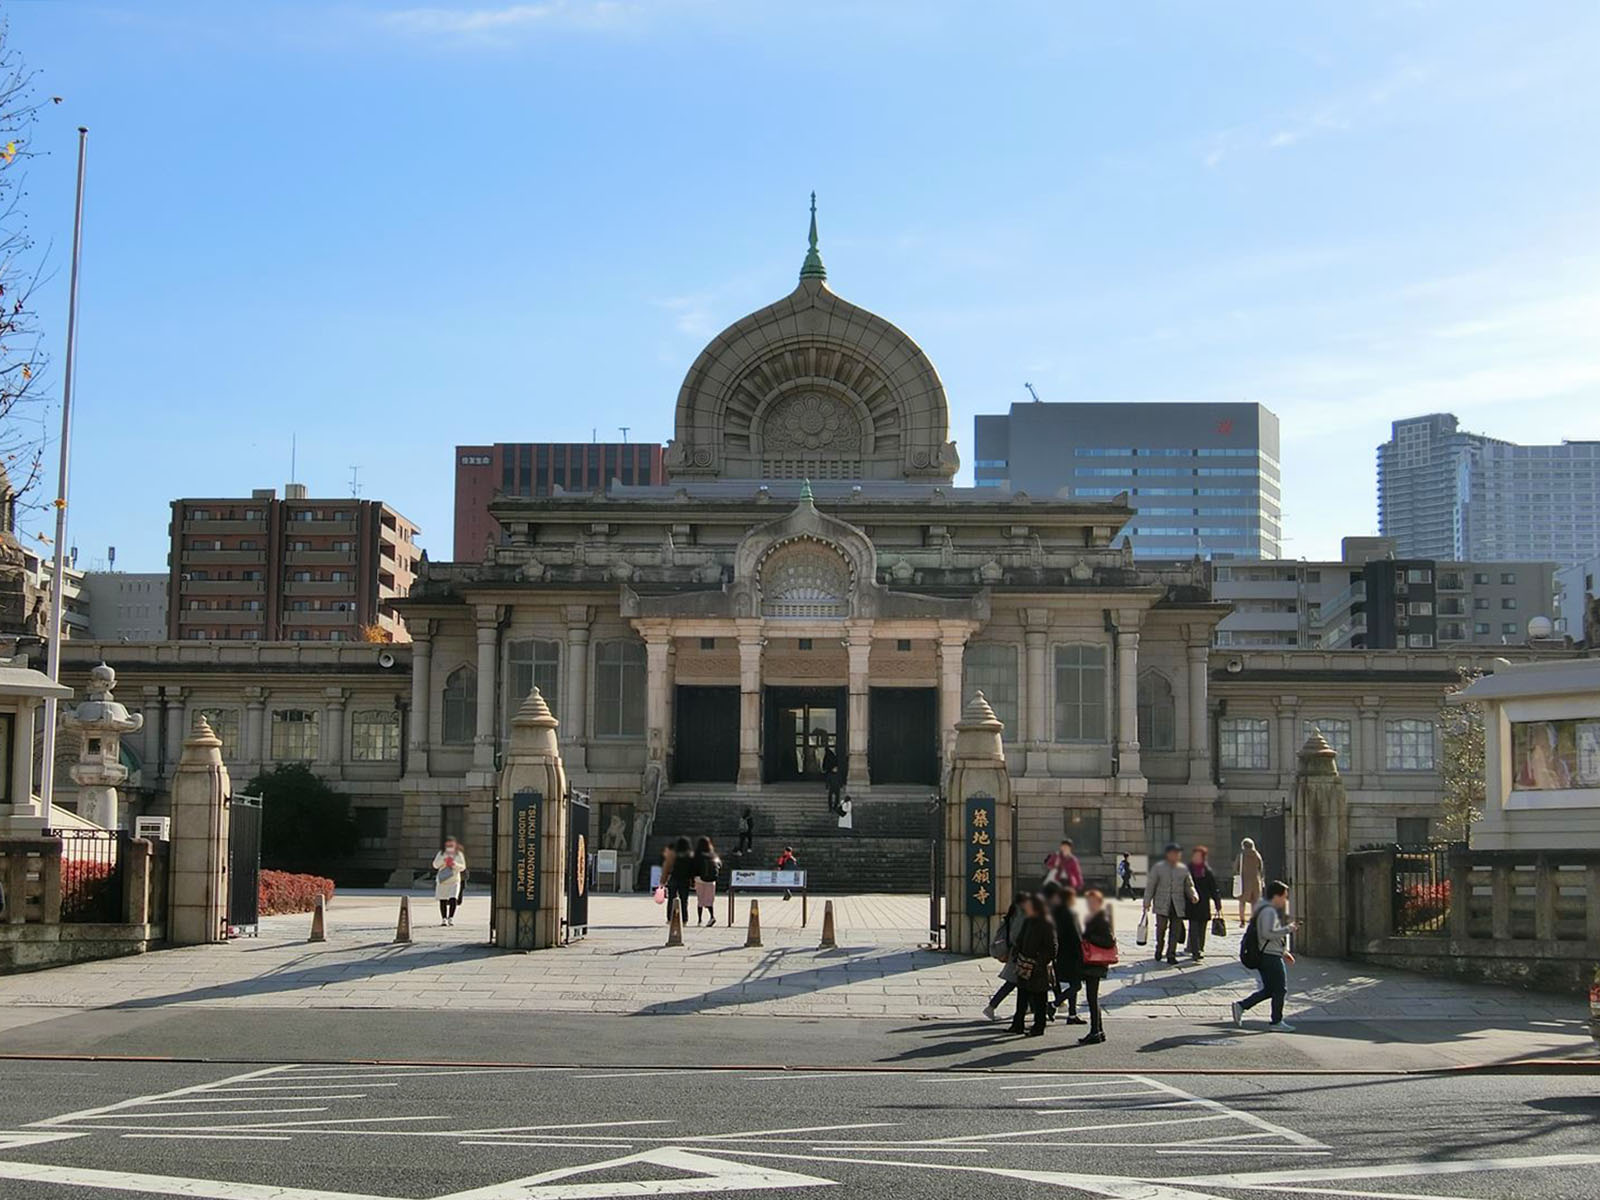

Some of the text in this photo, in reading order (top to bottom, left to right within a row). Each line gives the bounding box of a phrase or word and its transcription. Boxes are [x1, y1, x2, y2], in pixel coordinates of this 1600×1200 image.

[517, 811, 526, 892] BUDDHIST TEMPLE
[526, 803, 537, 900] TSUKIJI HONGWANJI
[972, 809, 991, 904] 築地本願寺
